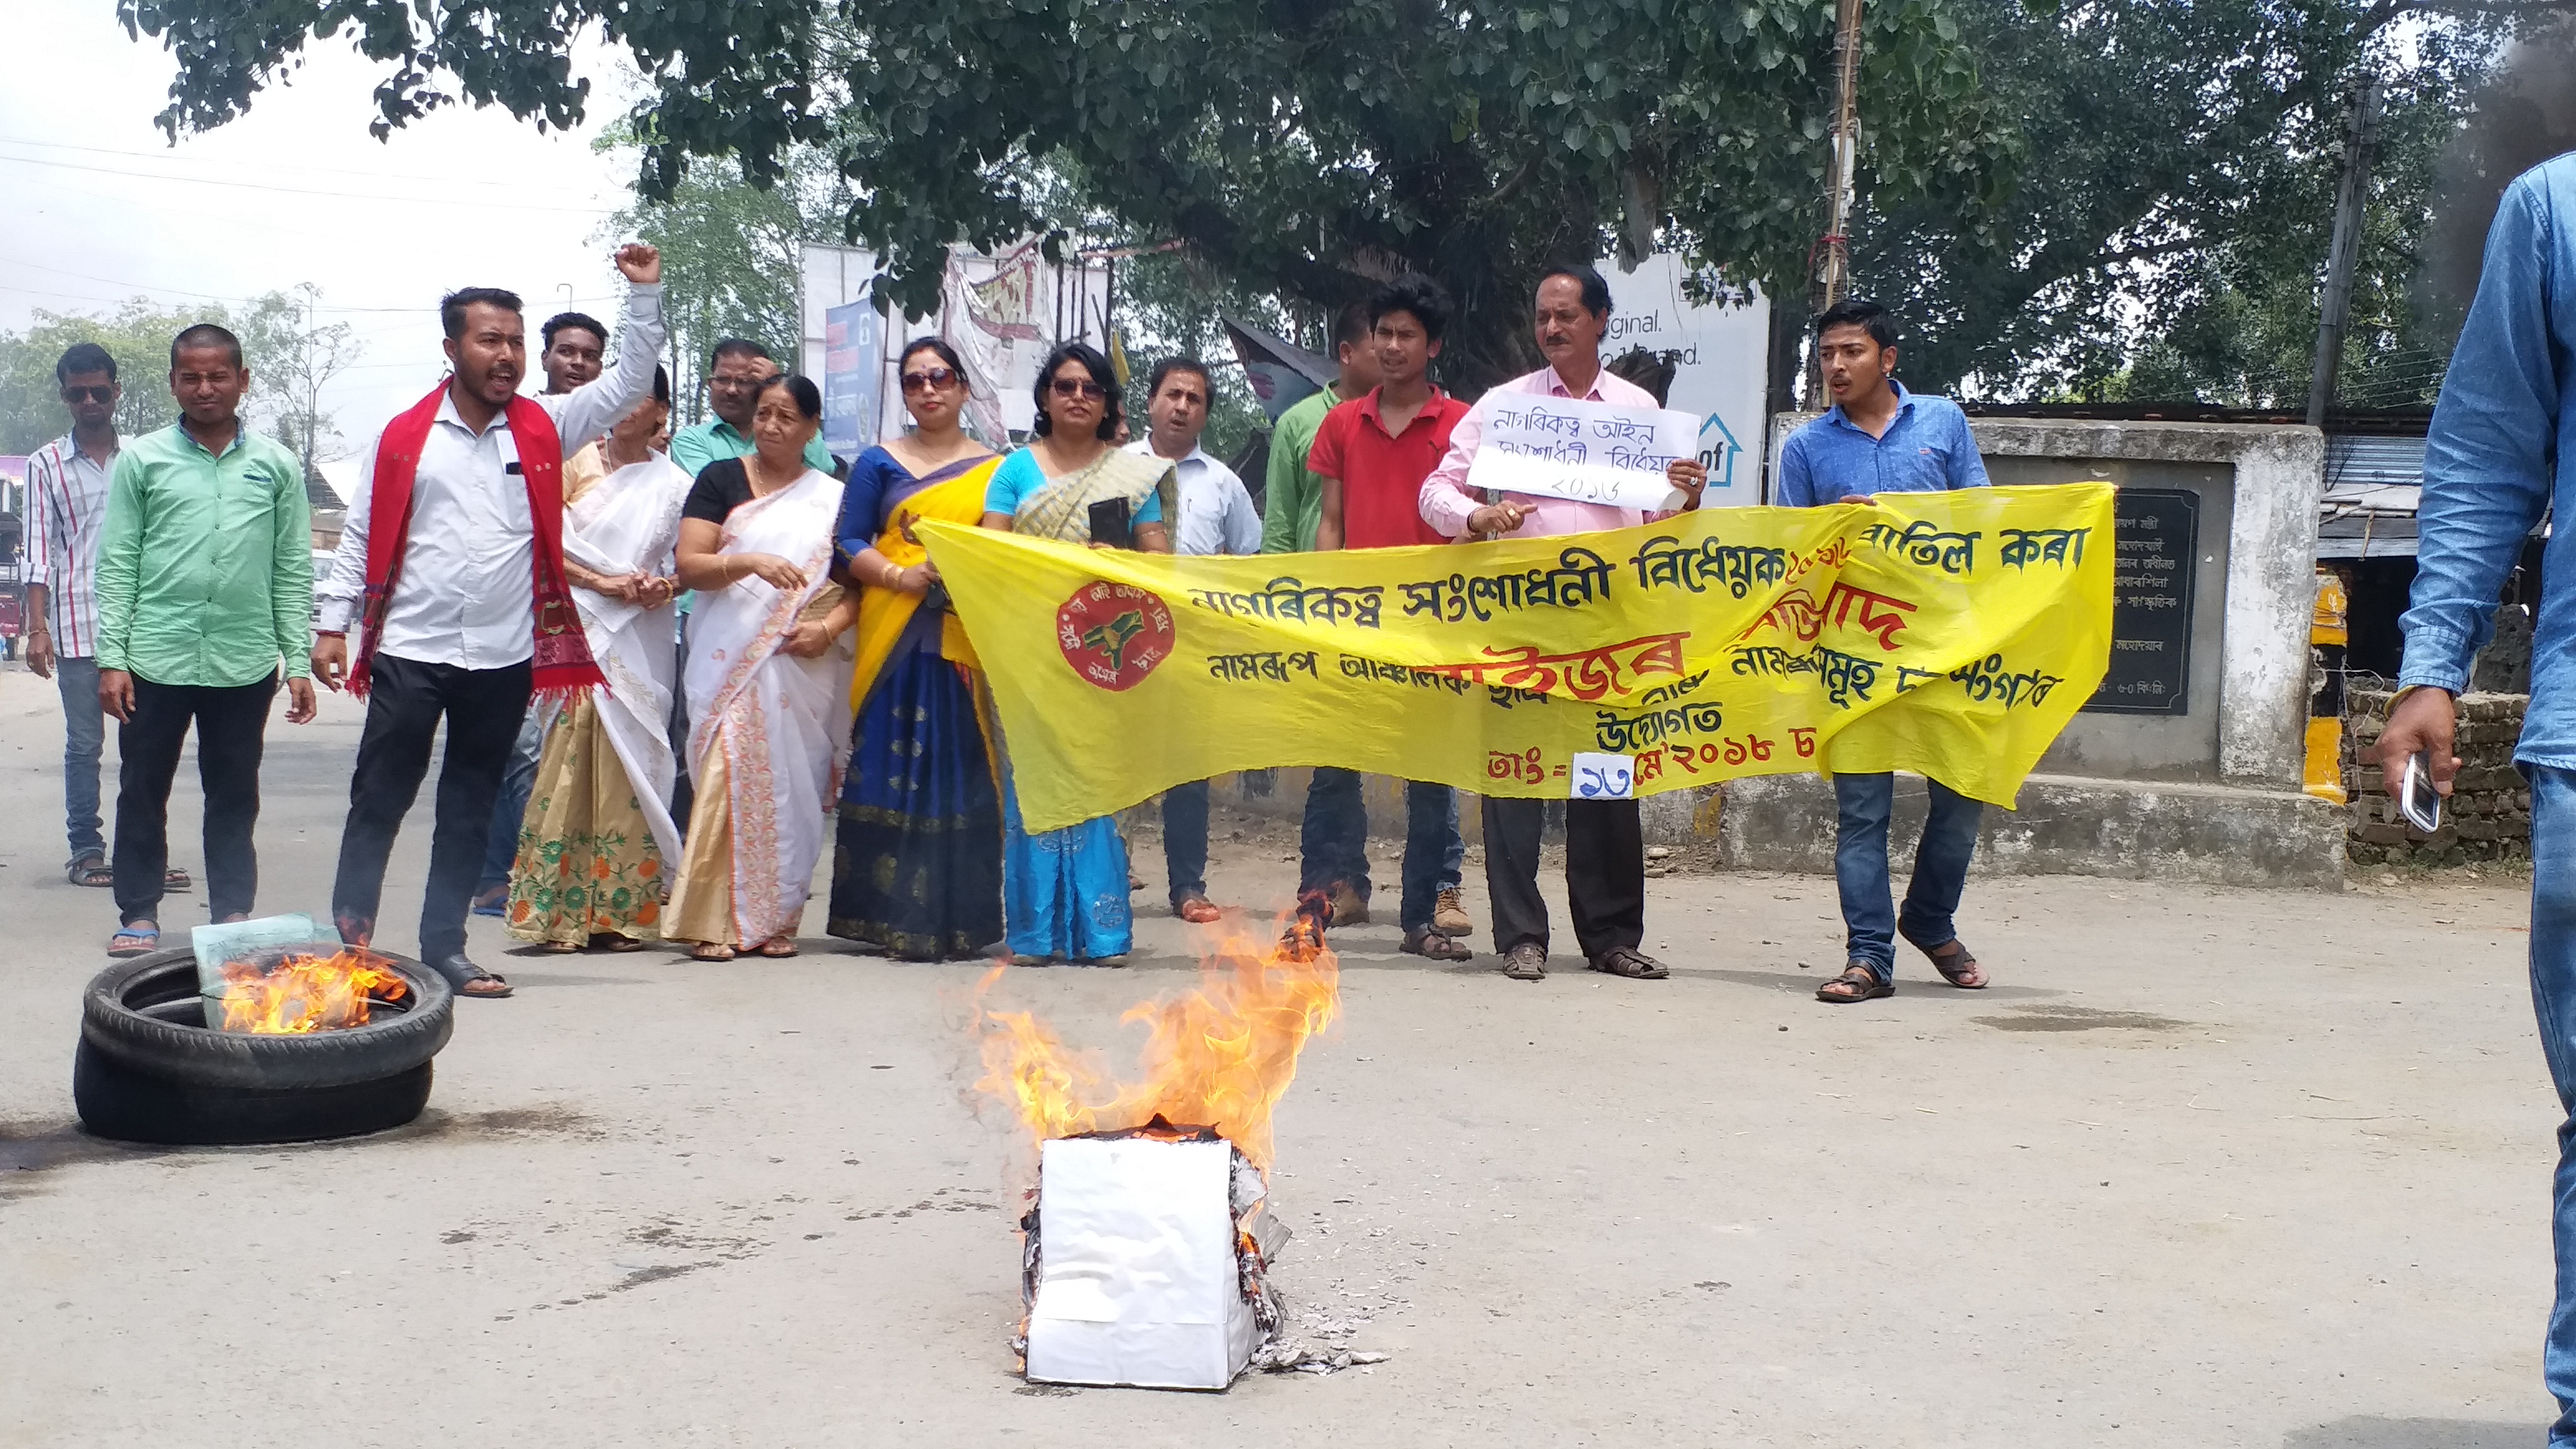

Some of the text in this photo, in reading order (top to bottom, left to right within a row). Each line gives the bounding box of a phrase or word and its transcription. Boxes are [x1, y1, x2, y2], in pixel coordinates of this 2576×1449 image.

[1606, 309, 1662, 339] ginal.
[1593, 415, 1656, 444] আইন
[1695, 442, 1723, 471] of
[1187, 576, 1385, 630] নাগৰিকত্ব
[1398, 547, 1618, 624] সংশোধনী
[1629, 536, 1786, 599] বিধেয়ক
[1999, 527, 2092, 576] কৰা
